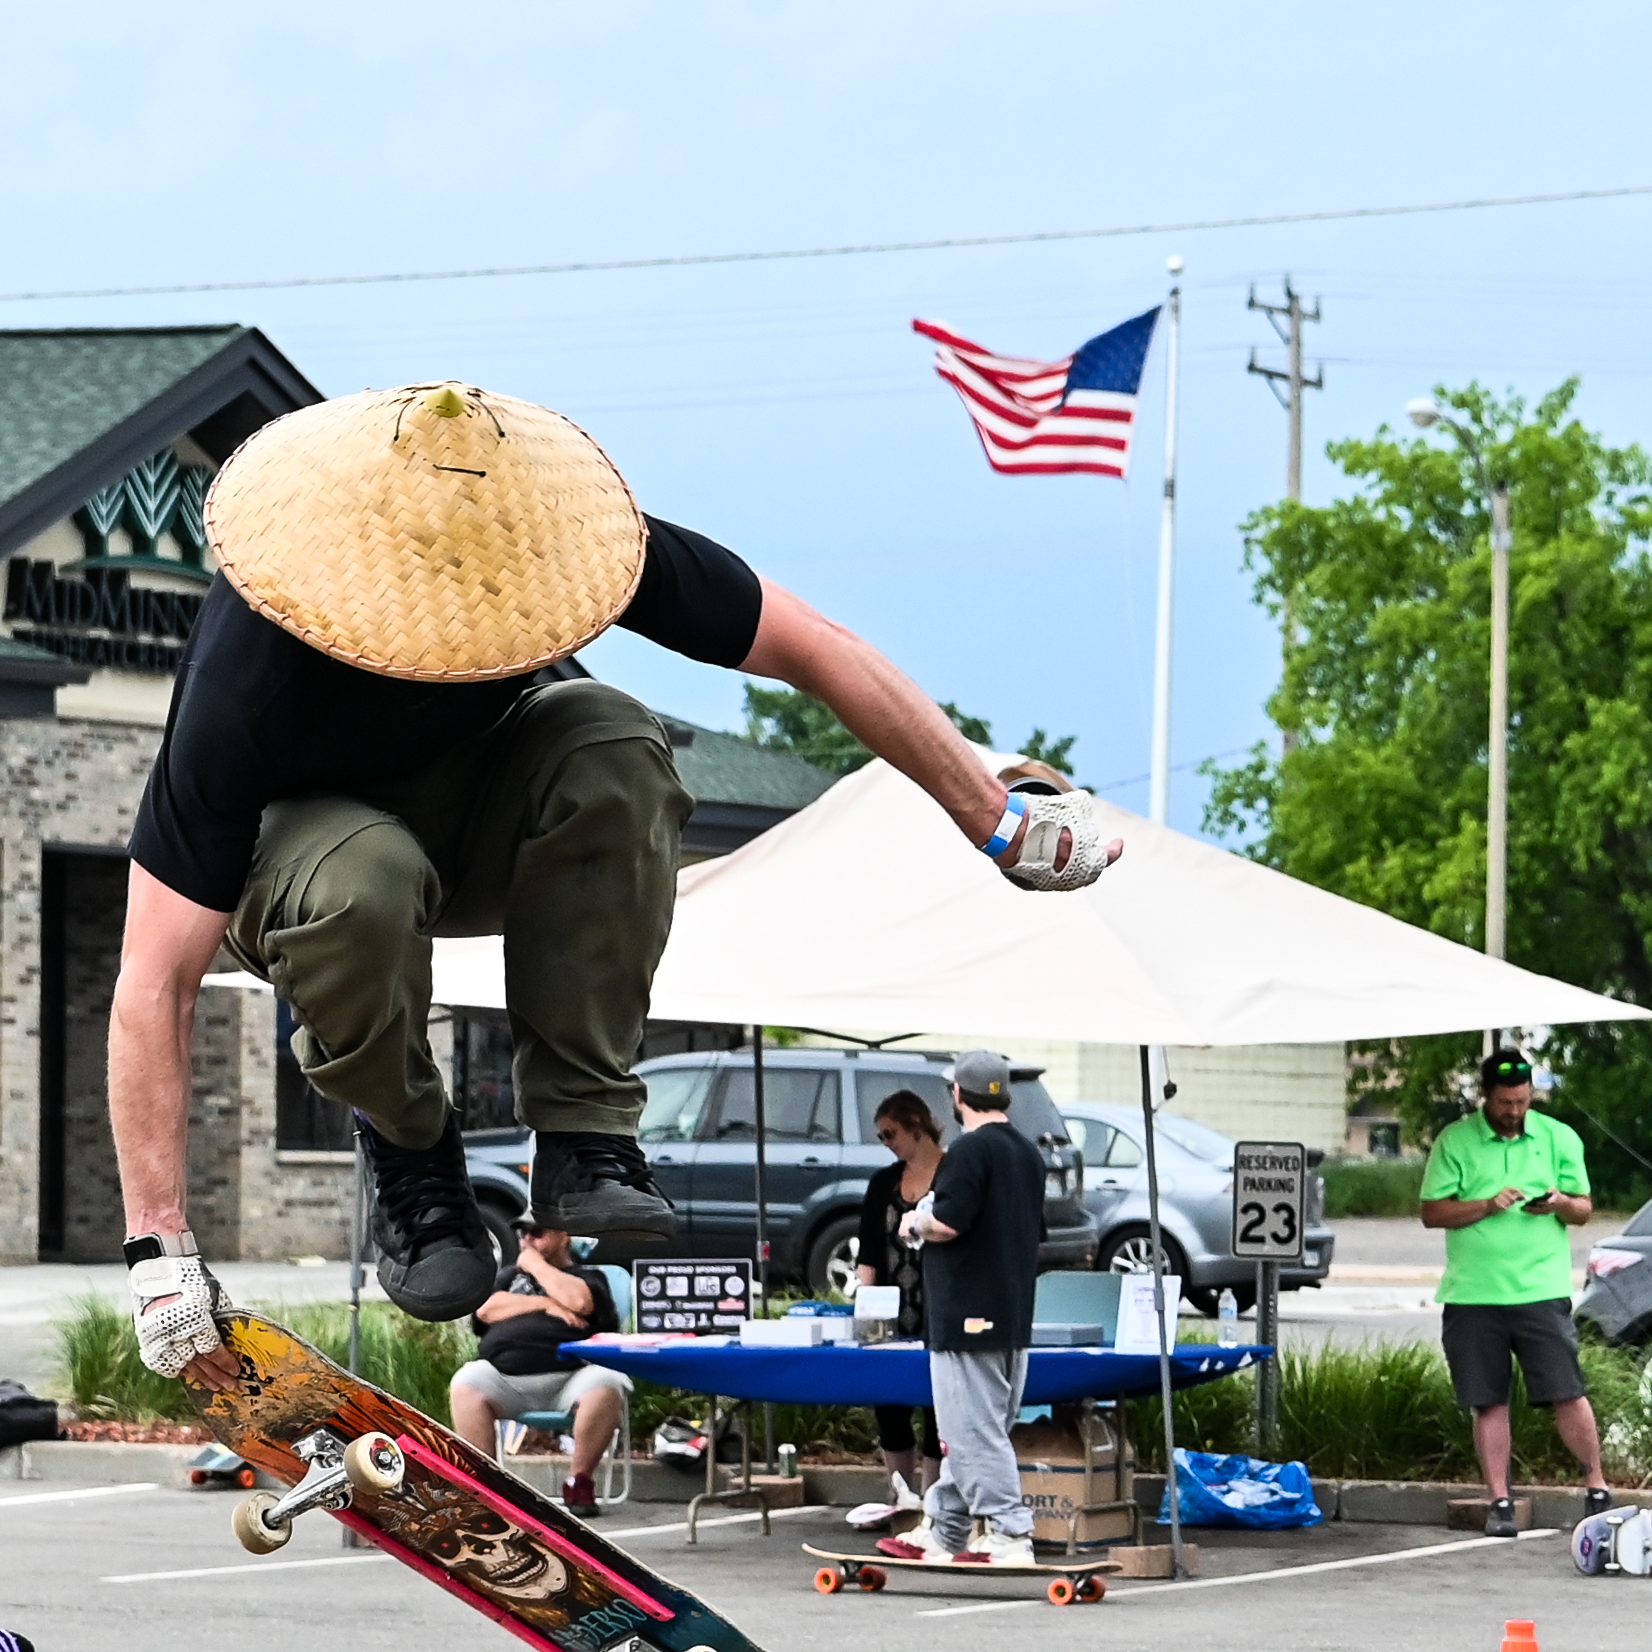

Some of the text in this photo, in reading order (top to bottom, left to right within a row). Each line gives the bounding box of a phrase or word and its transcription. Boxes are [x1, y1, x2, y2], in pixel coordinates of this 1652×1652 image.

[1237, 1153, 1301, 1172] RESERVED
[1242, 1175, 1295, 1194] PARKING
[1239, 1201, 1297, 1246] 23
[1022, 1494, 1058, 1508] ORT
